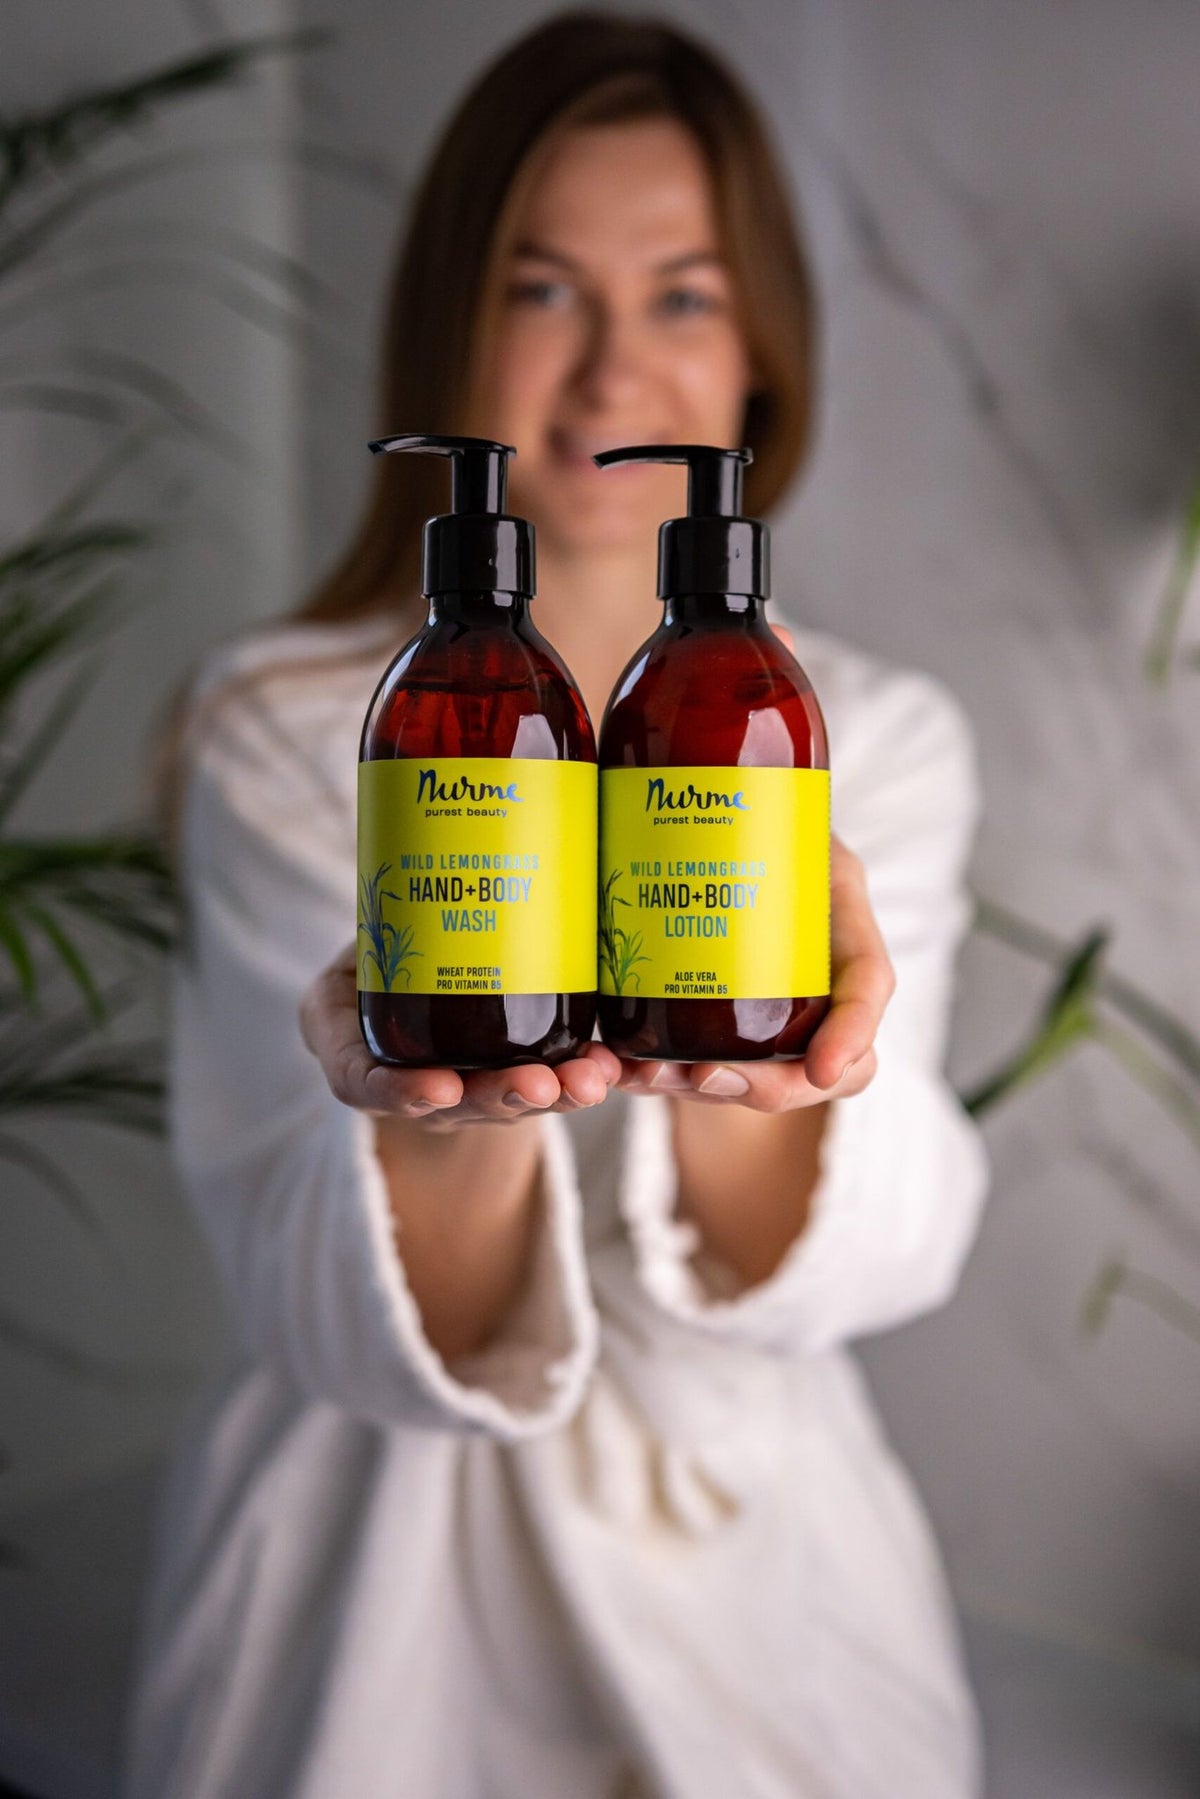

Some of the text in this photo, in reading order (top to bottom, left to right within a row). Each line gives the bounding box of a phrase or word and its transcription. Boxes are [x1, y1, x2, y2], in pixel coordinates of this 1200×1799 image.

[417, 769, 525, 804] Nurme
[645, 778, 751, 812] Nurme
[425, 807, 507, 818] purest beauty
[653, 816, 734, 826] purest beauty
[400, 854, 539, 870] WILD LEMONGRASS
[630, 861, 767, 877] WILD LEMONGRASS
[409, 877, 533, 903] HAND+BODY
[638, 883, 759, 909] HAND+BODY
[441, 909, 497, 932] WASH
[665, 915, 728, 938] LOTION
[437, 966, 502, 977] WHEAT PROTEIN
[674, 971, 717, 982] ALOE VERA
[436, 979, 502, 990] PRO VITAMIN B5
[664, 984, 728, 994] PRO VITAMIN B5
